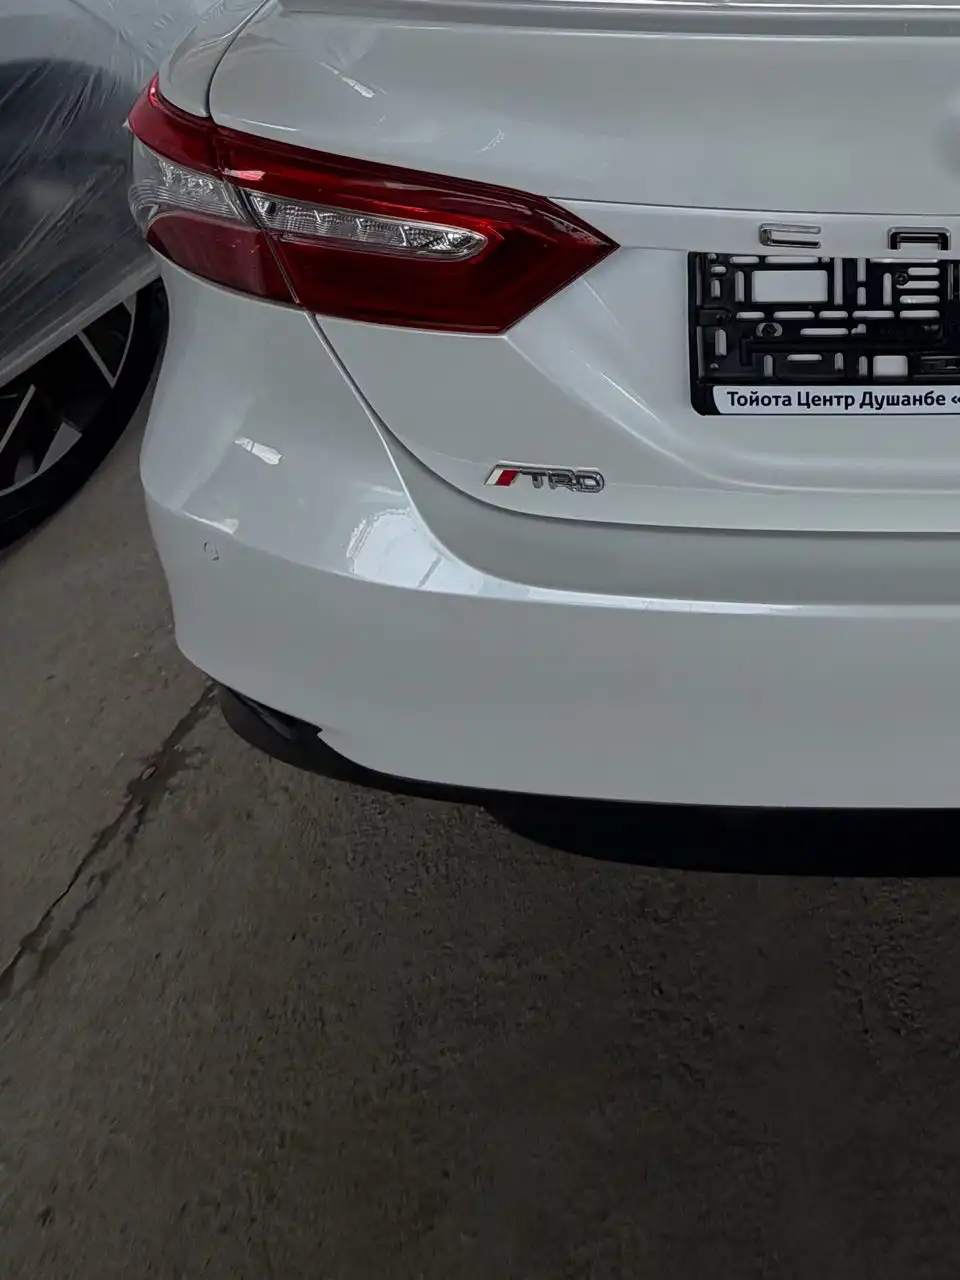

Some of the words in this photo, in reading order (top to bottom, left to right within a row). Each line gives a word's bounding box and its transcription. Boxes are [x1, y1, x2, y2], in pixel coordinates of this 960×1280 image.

[727, 390, 792, 407] Тойота
[797, 391, 856, 410] Центр
[859, 390, 946, 410] Душанбе
[508, 465, 606, 494] TRD
